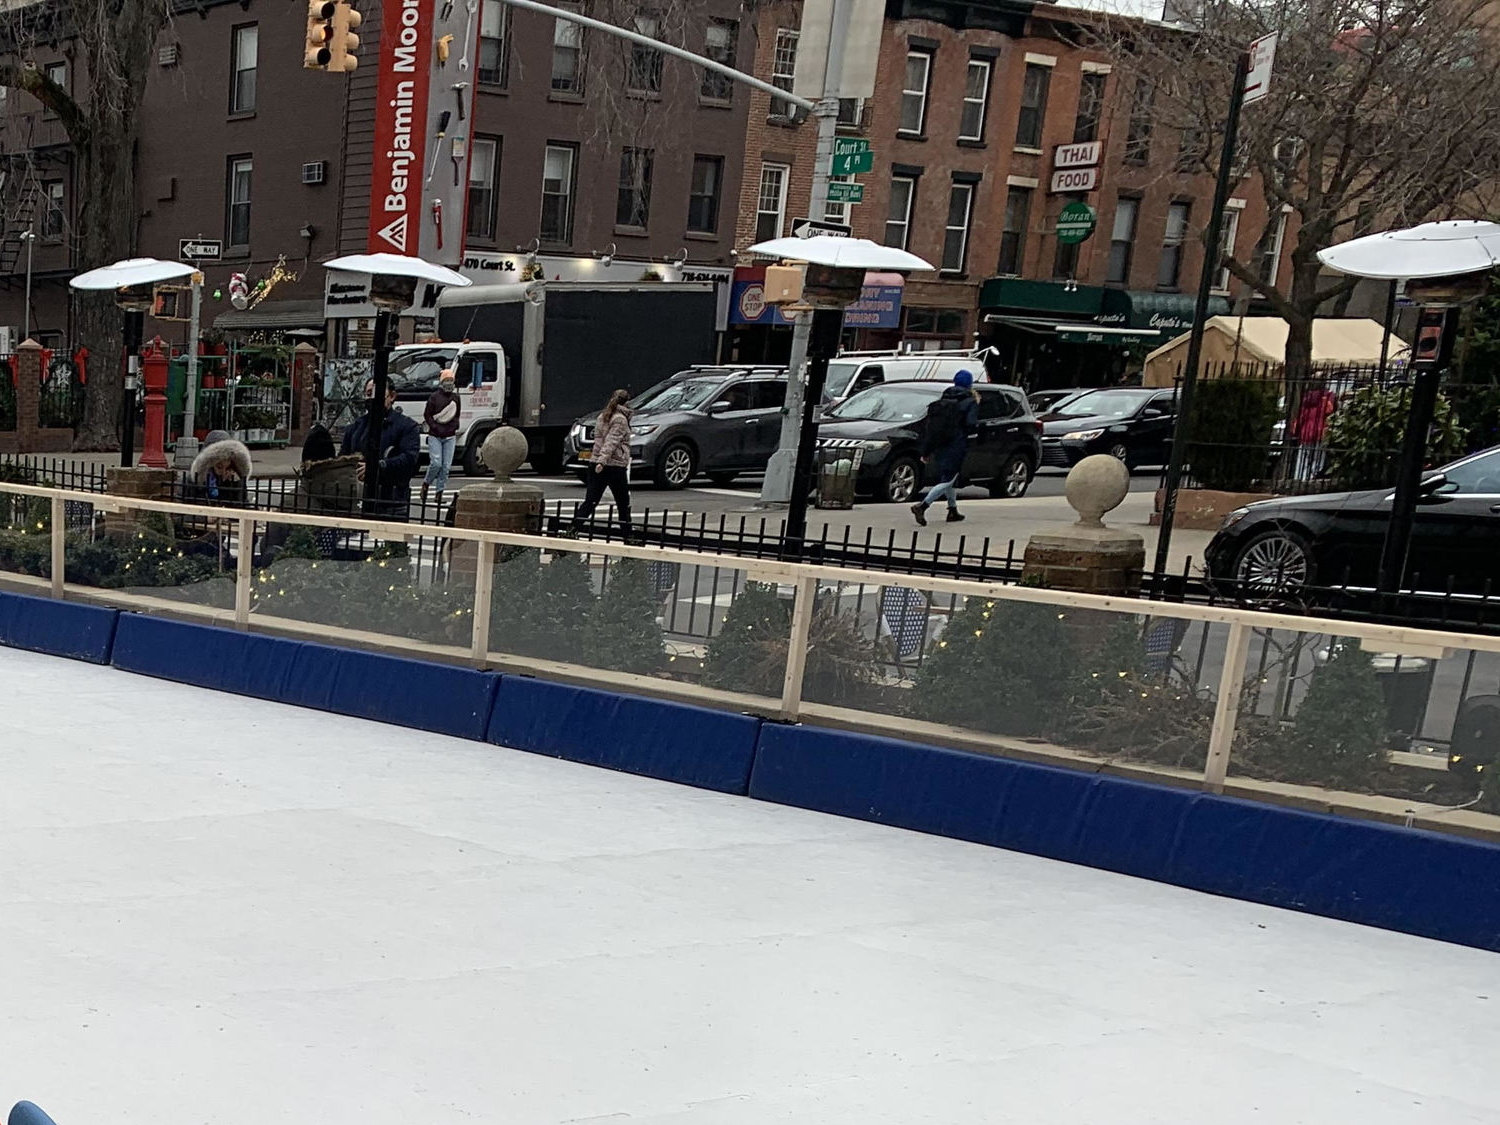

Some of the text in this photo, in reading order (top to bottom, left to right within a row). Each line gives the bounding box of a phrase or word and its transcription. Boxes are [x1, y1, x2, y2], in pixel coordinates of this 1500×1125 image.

[384, 80, 415, 212] Benjamin
[835, 139, 858, 154] Court
[1062, 146, 1094, 163] THAI
[843, 156, 851, 171] 4
[1057, 171, 1090, 188] FOOD
[186, 245, 198, 253] ONE
[480, 258, 503, 271] Court
[504, 260, 516, 272] St.
[747, 293, 761, 302] ONE
[744, 302, 763, 312] STOP
